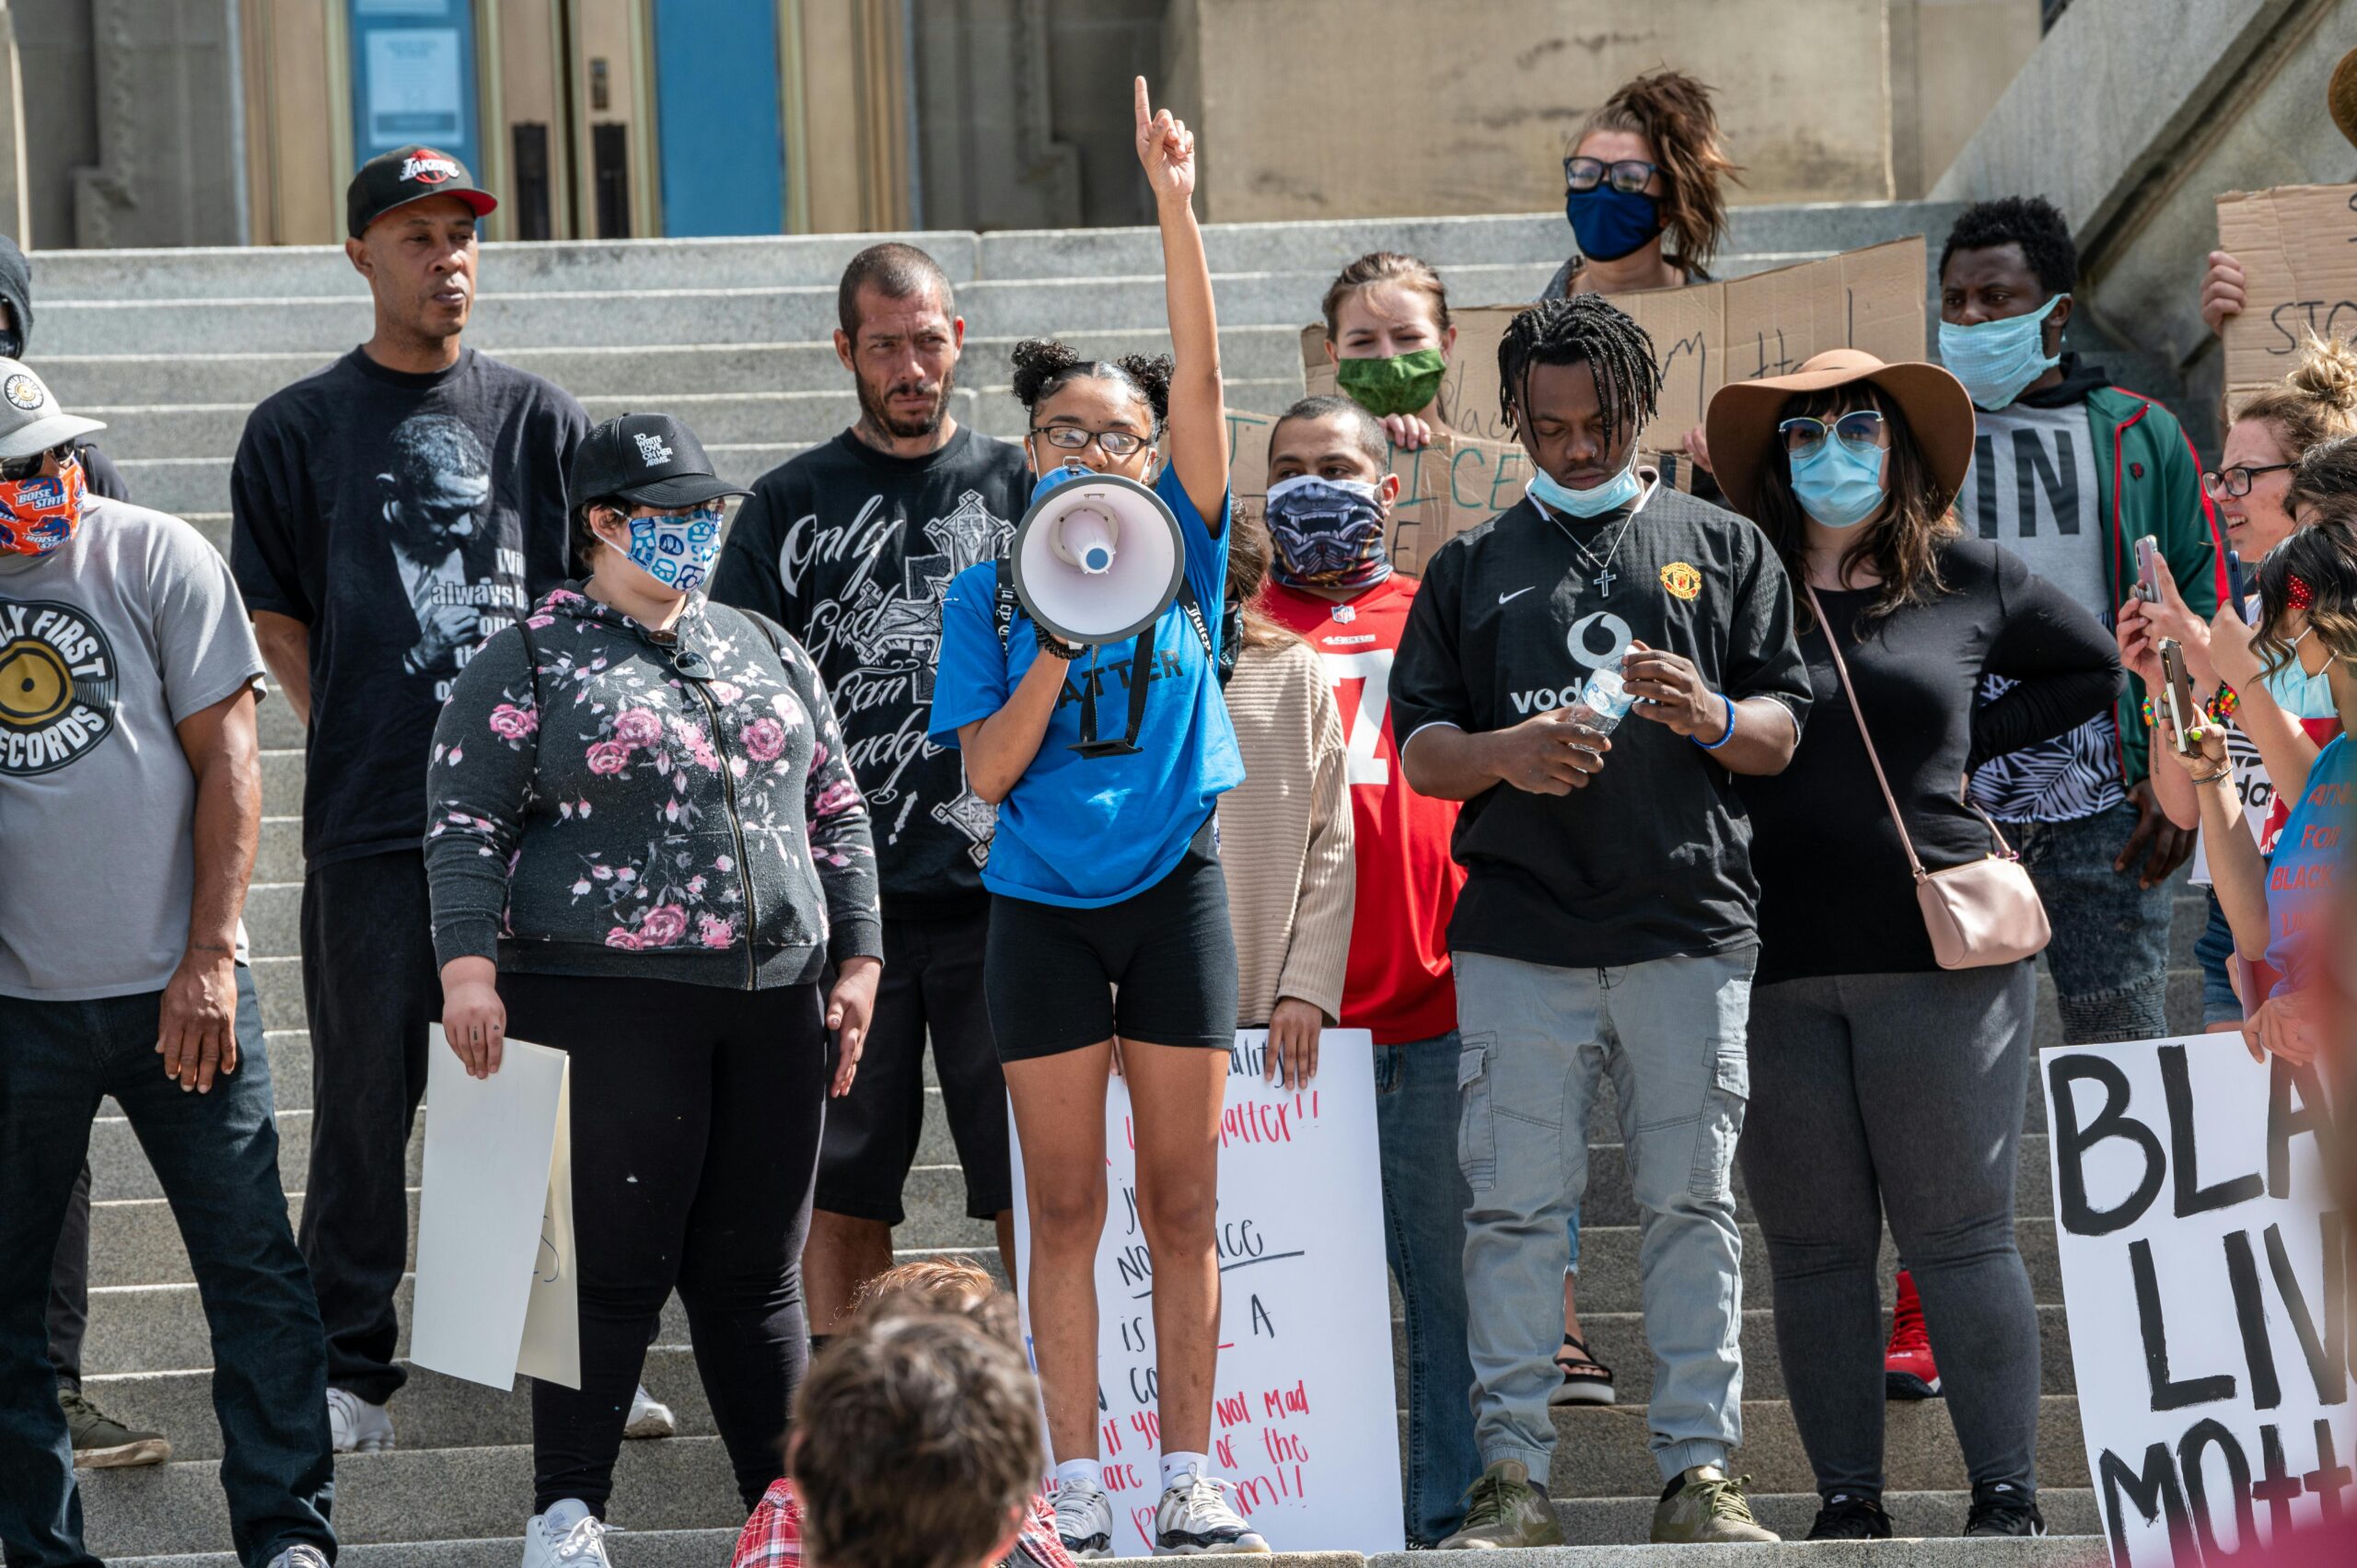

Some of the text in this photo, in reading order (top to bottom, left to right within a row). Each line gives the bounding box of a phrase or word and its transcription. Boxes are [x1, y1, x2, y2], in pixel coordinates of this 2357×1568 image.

[18, 488, 52, 504] BOISE
[780, 494, 904, 600] Only
[432, 581, 514, 609] always
[31, 610, 106, 678] FIRST
[1057, 650, 1184, 709] ATTER
[840, 708, 946, 805] udge
[2049, 1045, 2340, 1236] BLA
[1251, 1294, 1275, 1339] A
[2128, 1208, 2350, 1411] LIV
[1104, 1464, 1143, 1492] are
[1259, 1427, 1308, 1464] the
